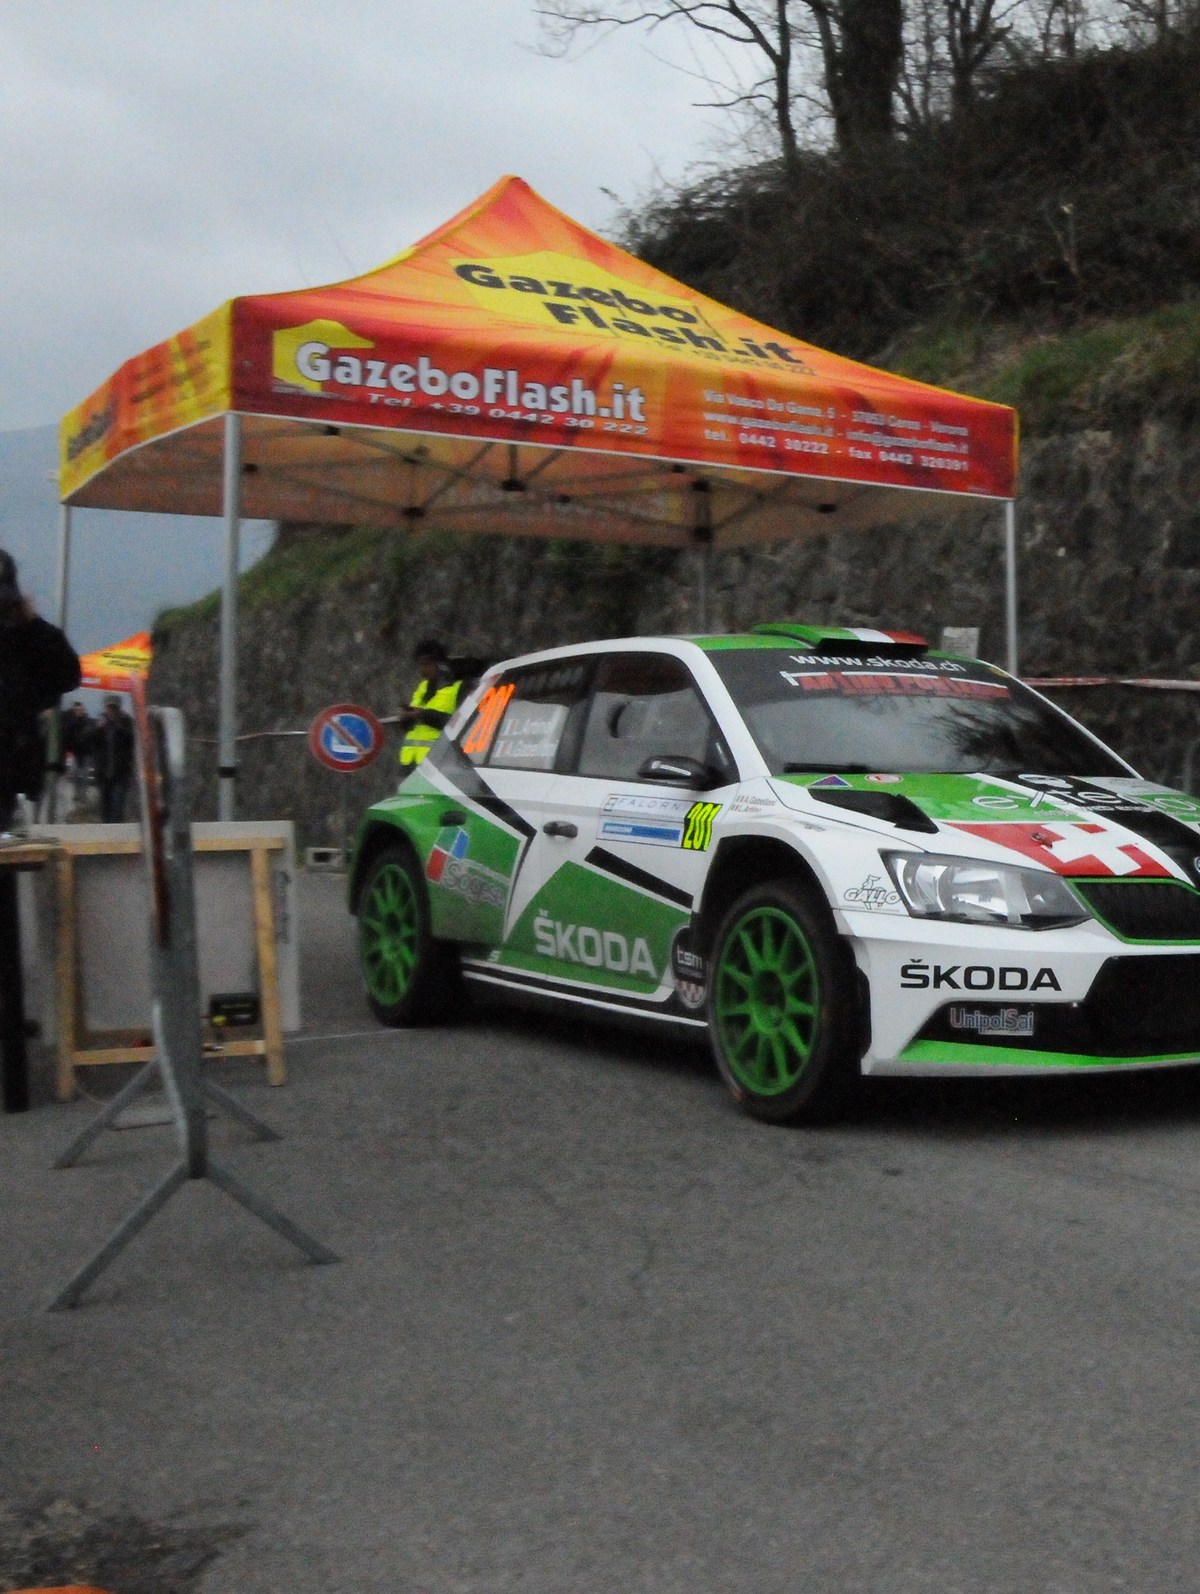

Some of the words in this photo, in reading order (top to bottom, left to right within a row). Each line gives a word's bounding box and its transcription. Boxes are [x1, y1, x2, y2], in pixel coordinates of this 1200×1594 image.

[455, 264, 697, 324] Gazebo
[542, 302, 803, 364] Flash.it
[295, 341, 646, 422] GazeboFlash.it
[430, 402, 480, 415] +39
[489, 408, 554, 425] 0442
[564, 417, 595, 429] 30
[603, 422, 649, 436] 222
[738, 432, 776, 448] 0442
[848, 447, 872, 460] fax
[790, 655, 967, 672] www.skoda.ch
[683, 802, 721, 851] 201
[844, 888, 901, 904] GALLO
[534, 908, 657, 979] ŠKODA
[900, 958, 1062, 991] ŠKODA
[950, 1007, 1035, 1033] UnipolSai
